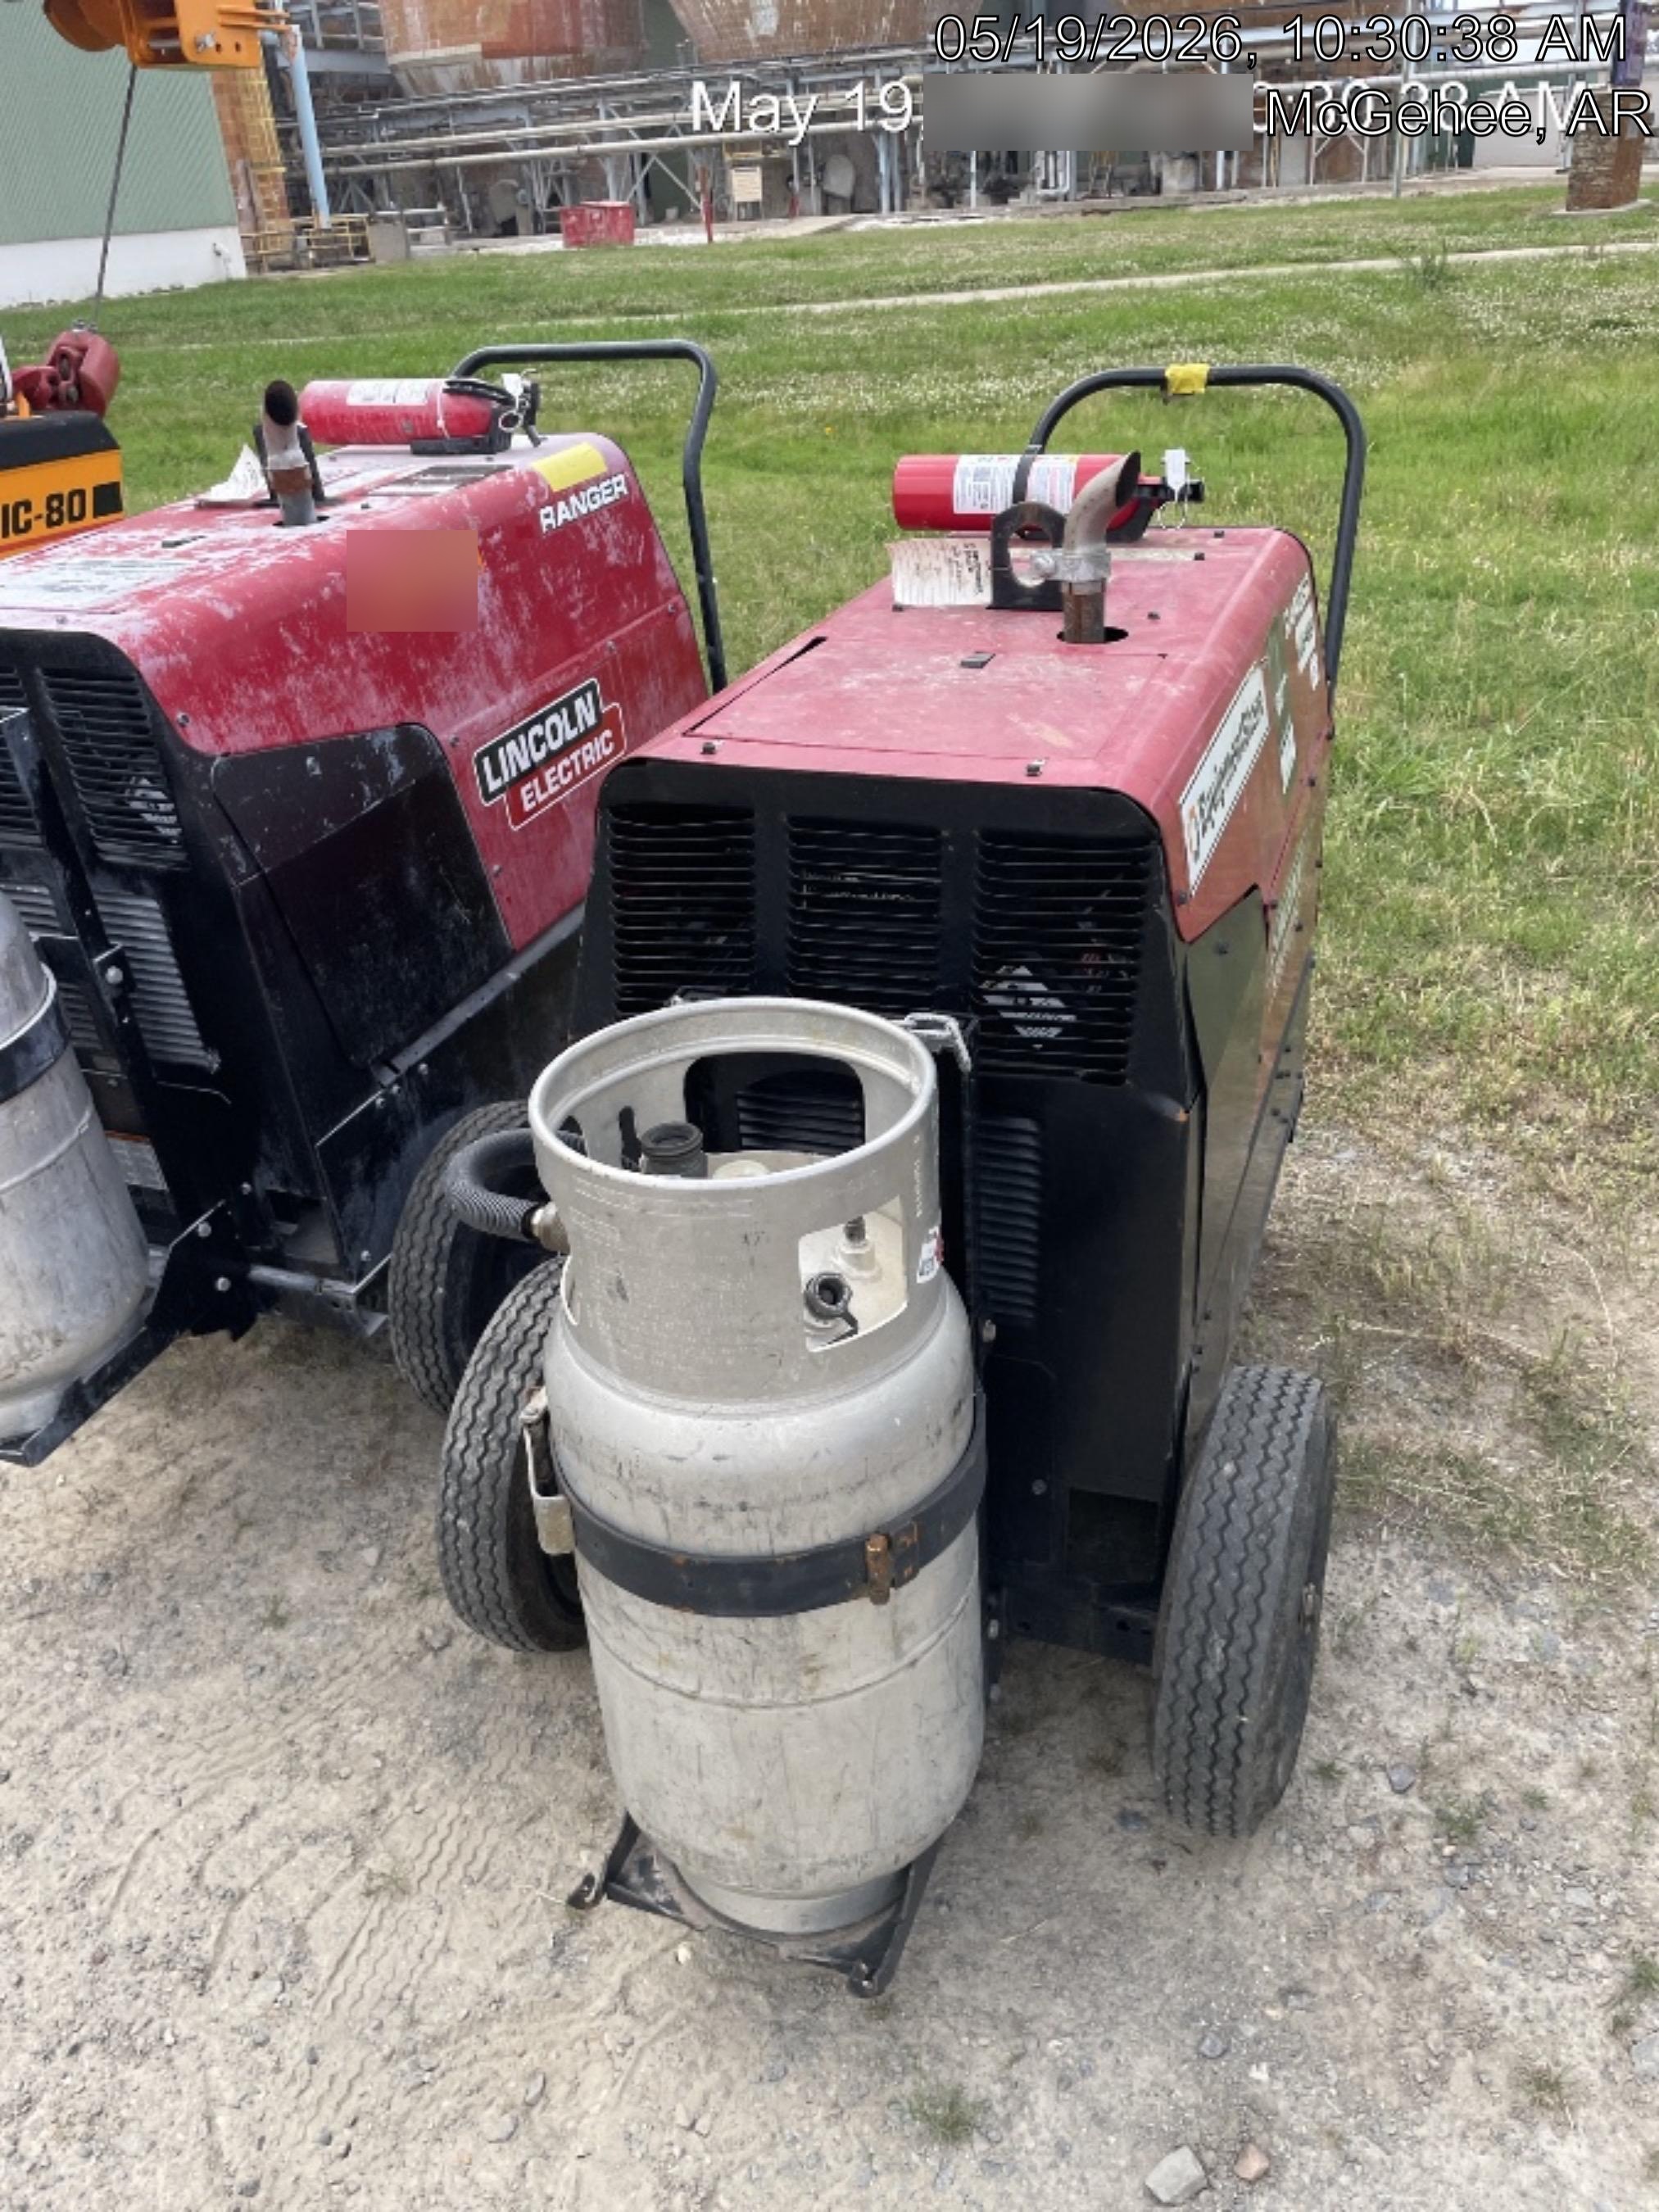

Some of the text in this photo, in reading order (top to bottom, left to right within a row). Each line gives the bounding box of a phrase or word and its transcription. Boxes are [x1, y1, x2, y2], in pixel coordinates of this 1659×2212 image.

[2, 488, 86, 538] IC-80
[539, 473, 629, 534] RANGER
[482, 691, 598, 794] LINCOLN
[519, 729, 614, 813] ELECTRIC
